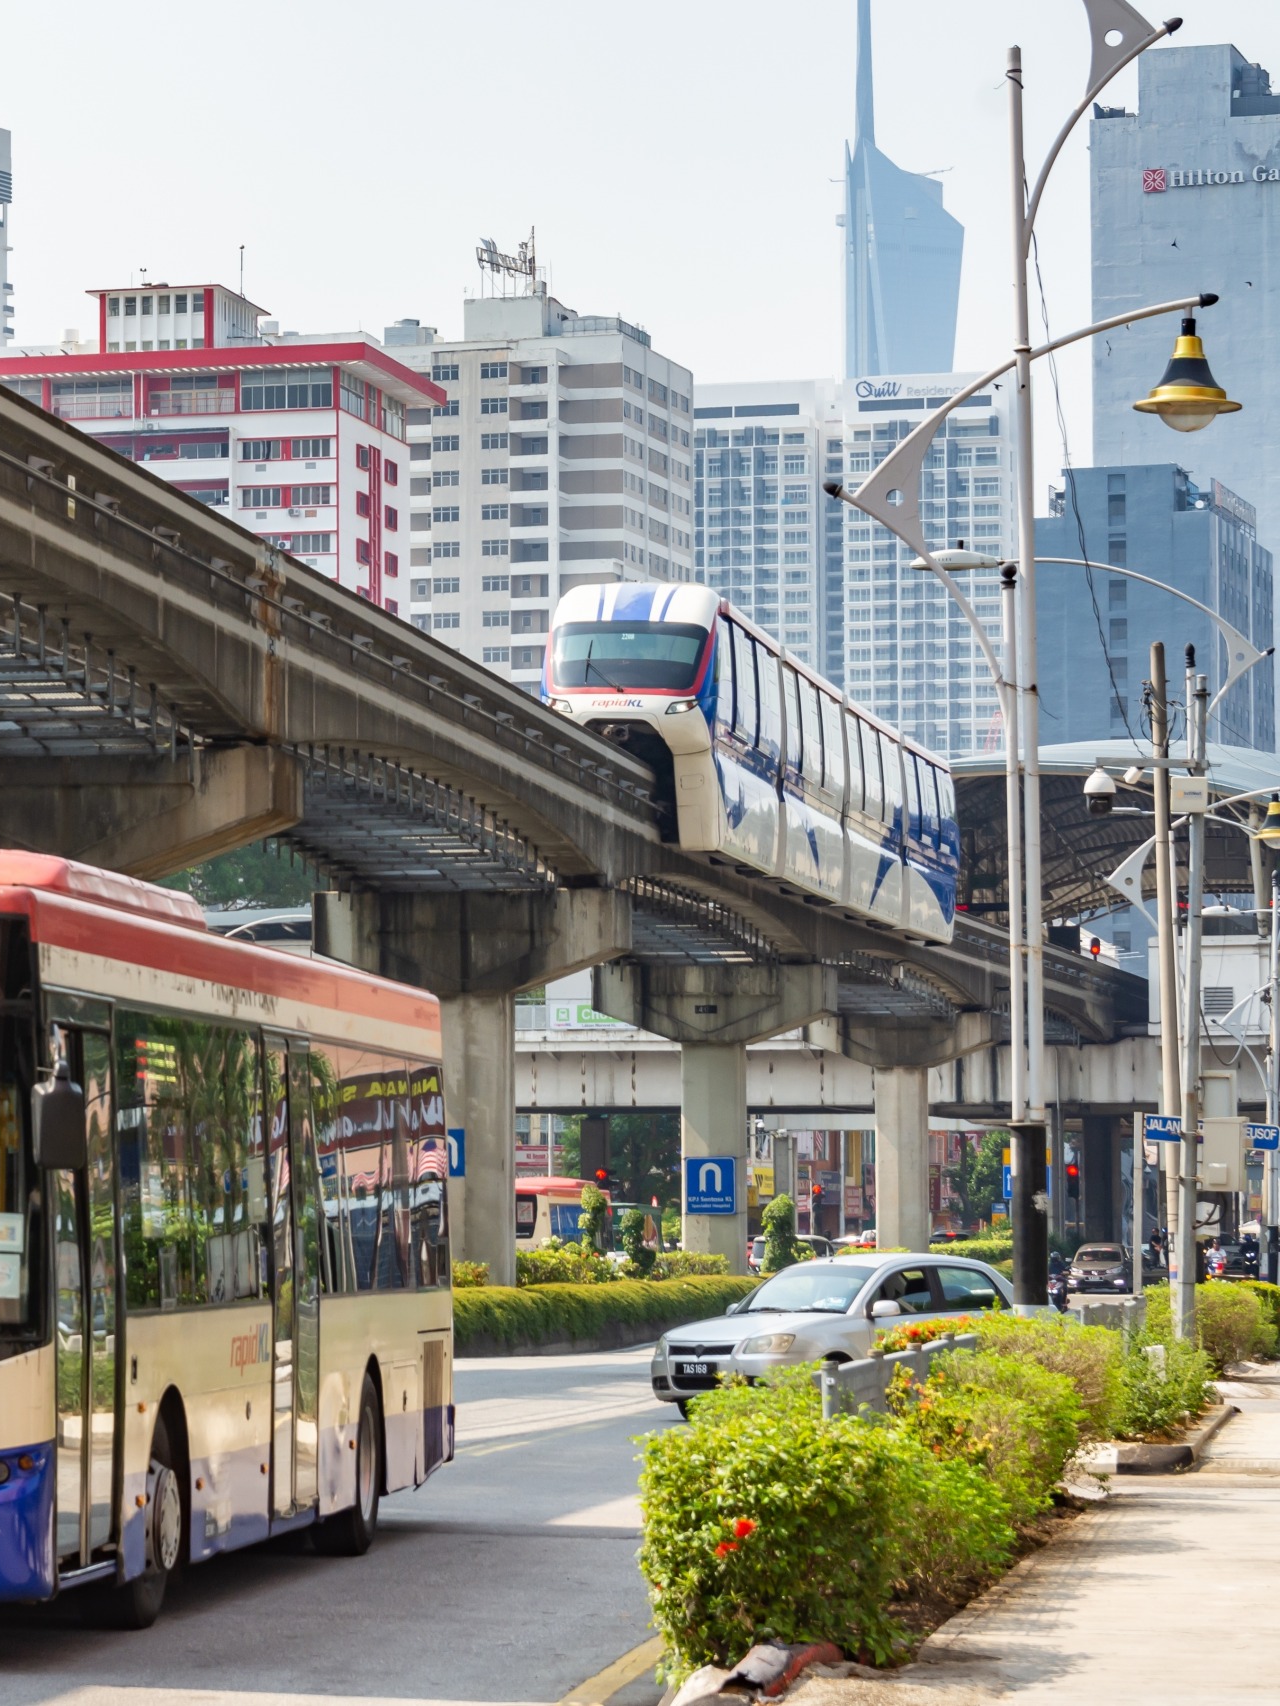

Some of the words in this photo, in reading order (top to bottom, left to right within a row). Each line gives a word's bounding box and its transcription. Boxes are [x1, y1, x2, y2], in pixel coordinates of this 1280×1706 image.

[1169, 168, 1245, 187] Hilton
[855, 380, 902, 398] Quill
[591, 699, 644, 708] rapidKL
[581, 1008, 613, 1021] Cho
[1146, 1118, 1181, 1133] JALAN
[230, 1322, 270, 1377] rapidKL
[682, 1363, 695, 1374] TAS
[695, 1363, 707, 1374] 168
